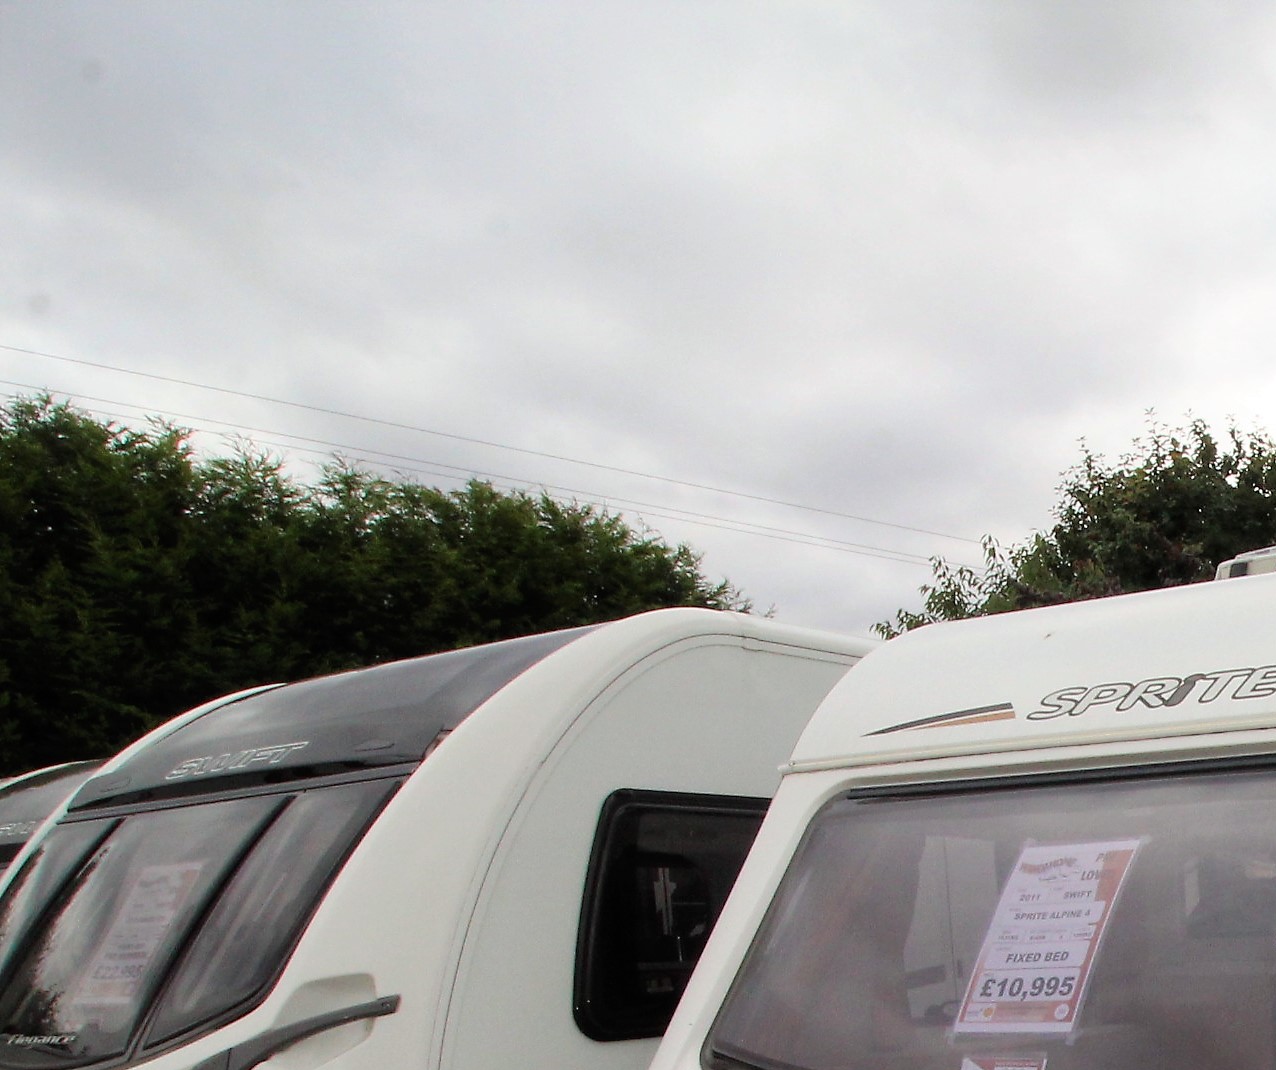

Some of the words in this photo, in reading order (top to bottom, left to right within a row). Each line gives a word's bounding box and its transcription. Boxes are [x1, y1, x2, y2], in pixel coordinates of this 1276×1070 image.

[165, 741, 309, 779] SWIFT
[1063, 890, 1092, 900] SWIFT
[1014, 911, 1047, 920] SPRITE
[1049, 909, 1082, 920] ALPINE
[1005, 952, 1042, 963] FIXED
[1044, 951, 1070, 962] BED
[980, 976, 1075, 1001] £10,995
